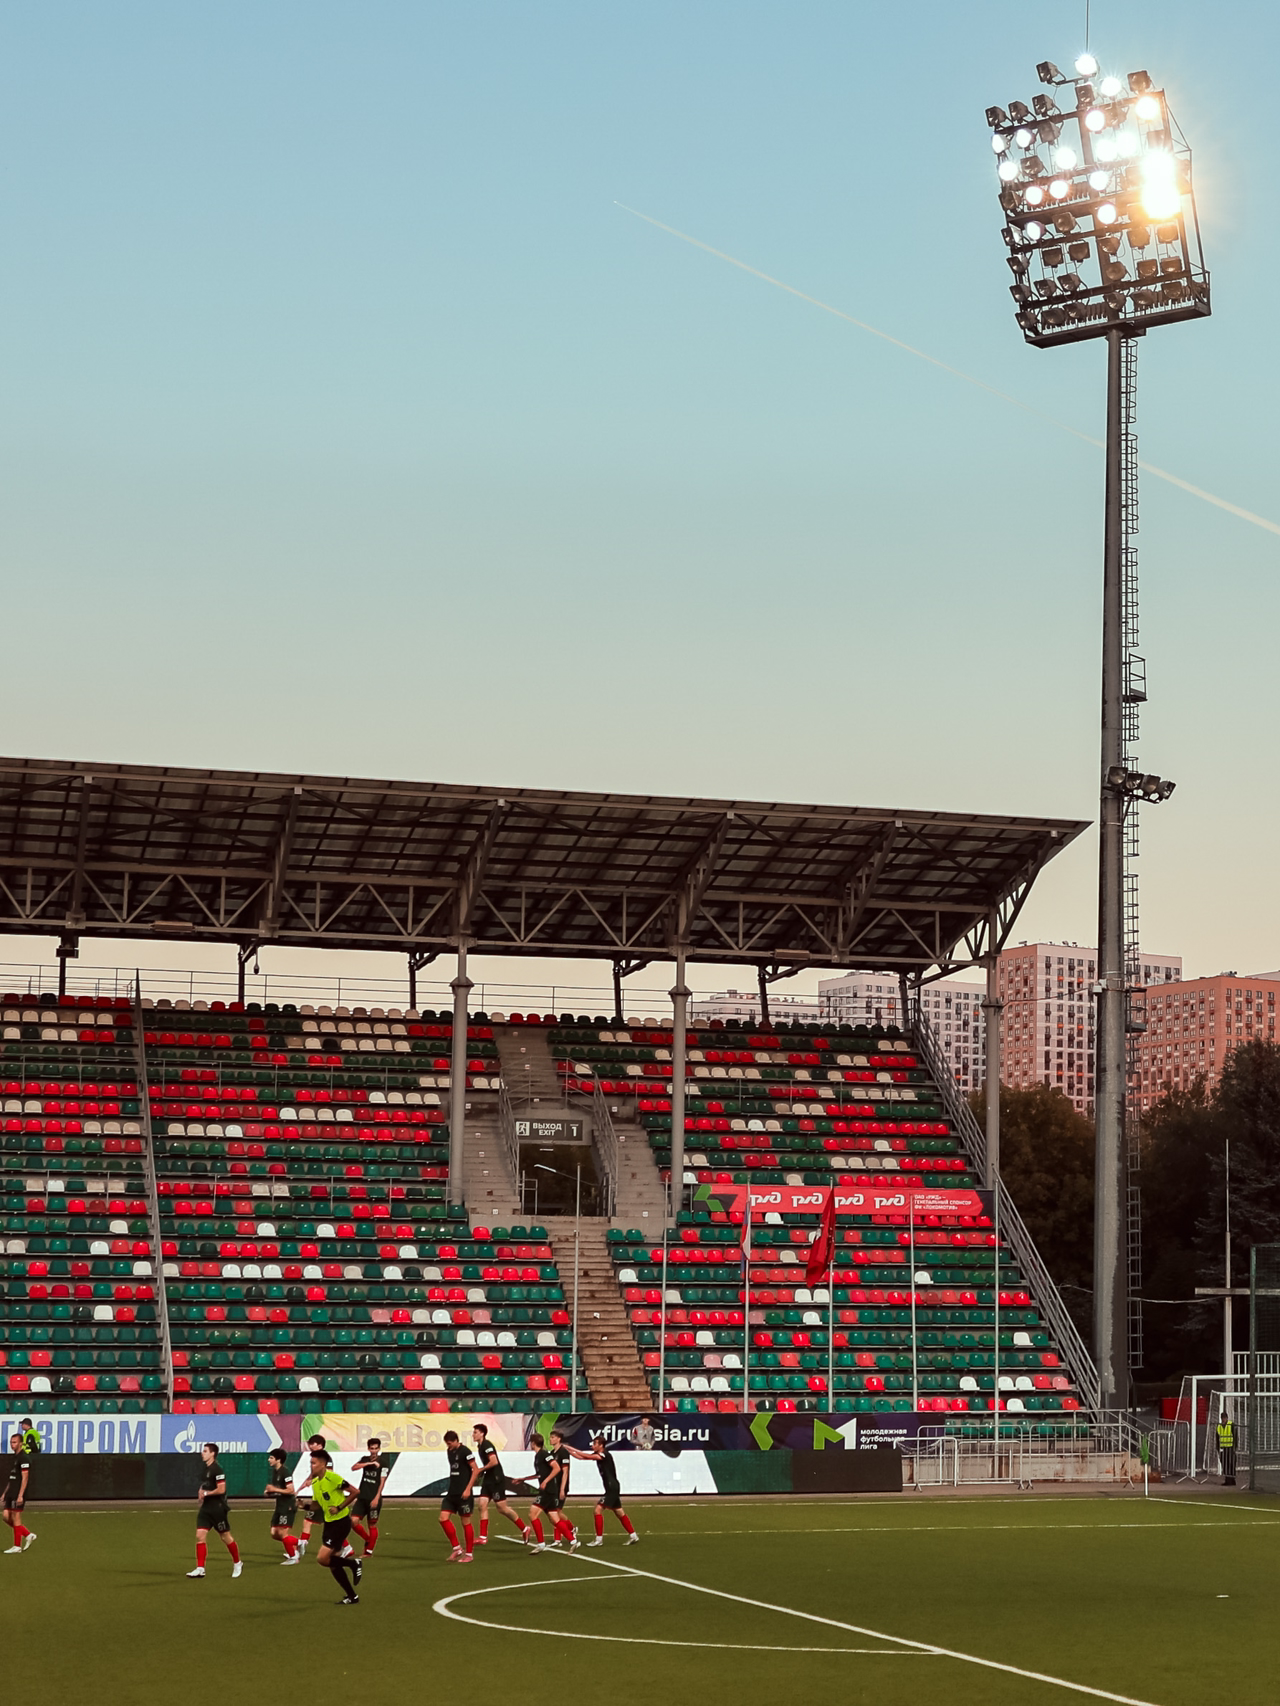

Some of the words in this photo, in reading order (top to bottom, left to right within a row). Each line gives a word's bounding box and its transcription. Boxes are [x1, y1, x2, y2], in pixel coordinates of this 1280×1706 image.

[532, 1122, 562, 1130] ВЫХОД
[571, 1126, 577, 1137] 1
[1, 1421, 147, 1454] ГЗПРОМ
[356, 1424, 478, 1449] BetBom
